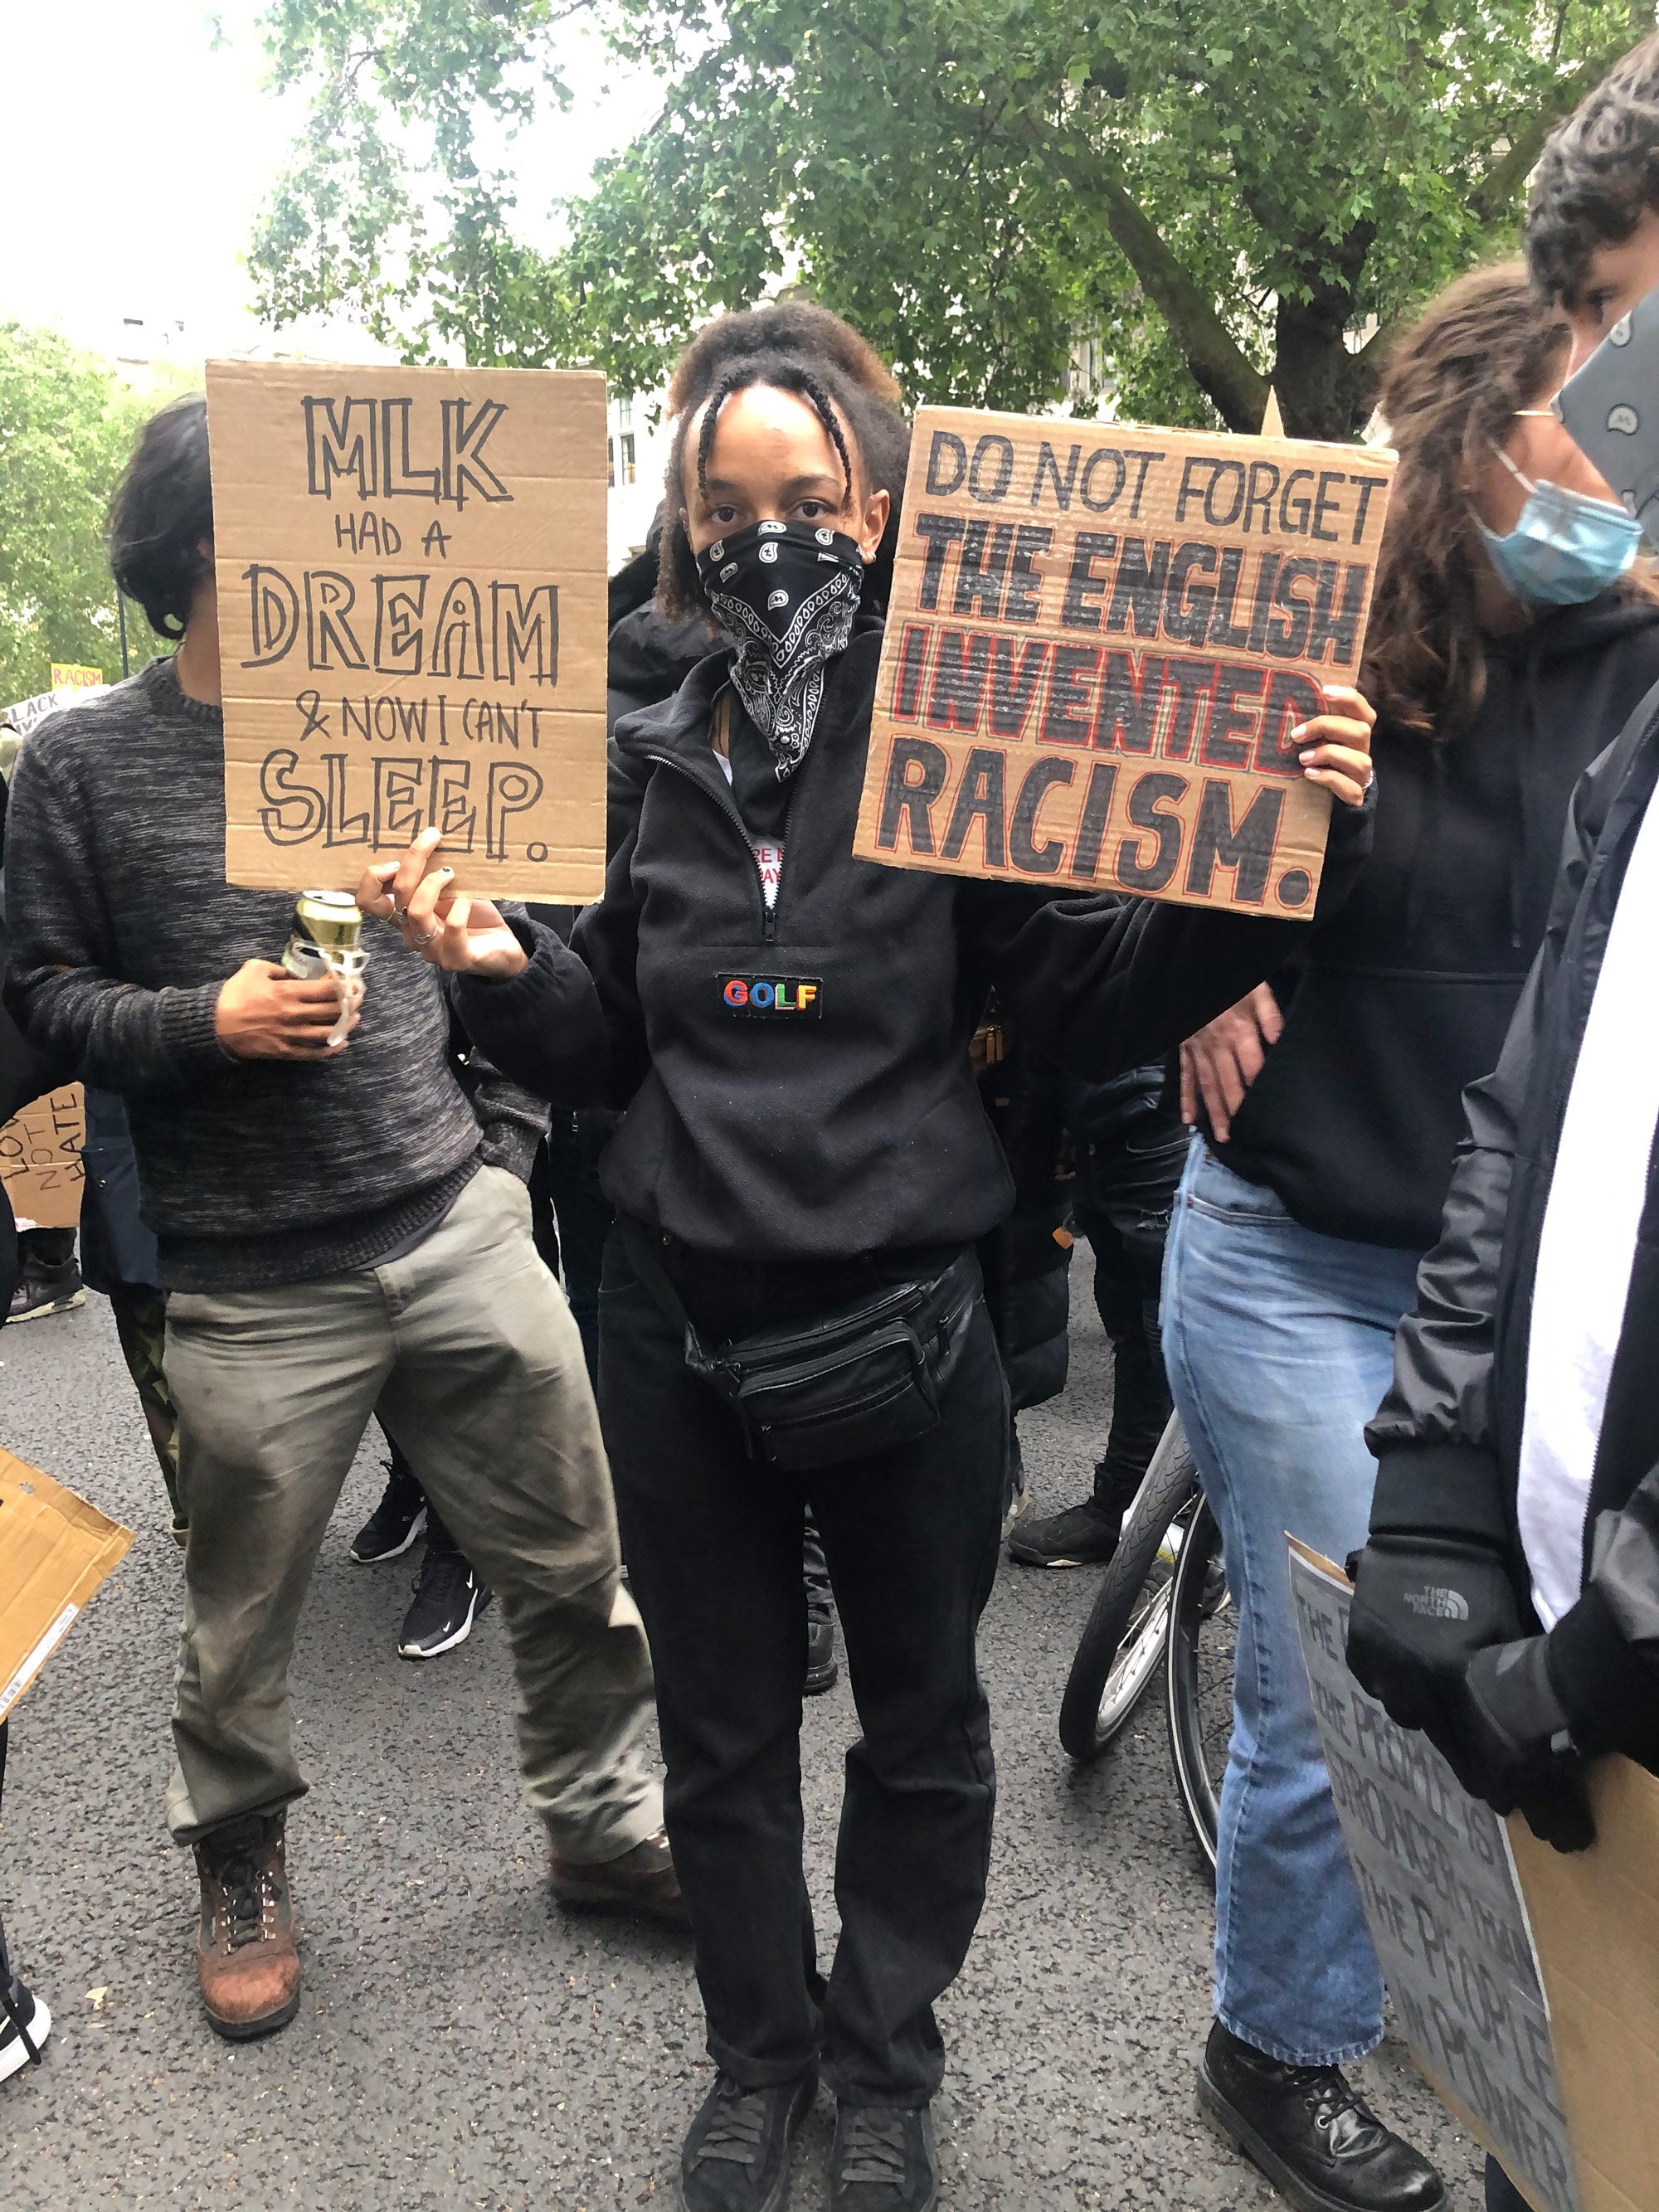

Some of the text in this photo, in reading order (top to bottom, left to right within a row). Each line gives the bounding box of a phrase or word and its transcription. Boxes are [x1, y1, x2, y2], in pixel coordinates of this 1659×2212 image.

[301, 395, 514, 511] MLK
[925, 430, 1389, 545] DO NOT FORGET
[335, 511, 452, 560] HAD A
[913, 512, 1371, 668] THE ENGLISH
[53, 667, 101, 688] RACISM
[241, 564, 560, 686] DREAM
[295, 689, 542, 749] & NOW I CAN'T
[889, 621, 1328, 779] INVENTED
[258, 749, 548, 863] SLEEP.
[874, 733, 1313, 909] RACISM.
[723, 980, 817, 1012] GOLF
[23, 1123, 61, 1190] NOT
[50, 1092, 85, 1183] HATE
[1404, 1592, 1447, 1607] NORTH
[1413, 1606, 1444, 1618] FACE
[1423, 1586, 1448, 1598] THE
[1351, 1690, 1460, 1840] PEOPLE
[1462, 1798, 1495, 1866] IS
[1354, 1853, 1568, 2127] THE PEOPLE
[1428, 1993, 1575, 2212] POWER
